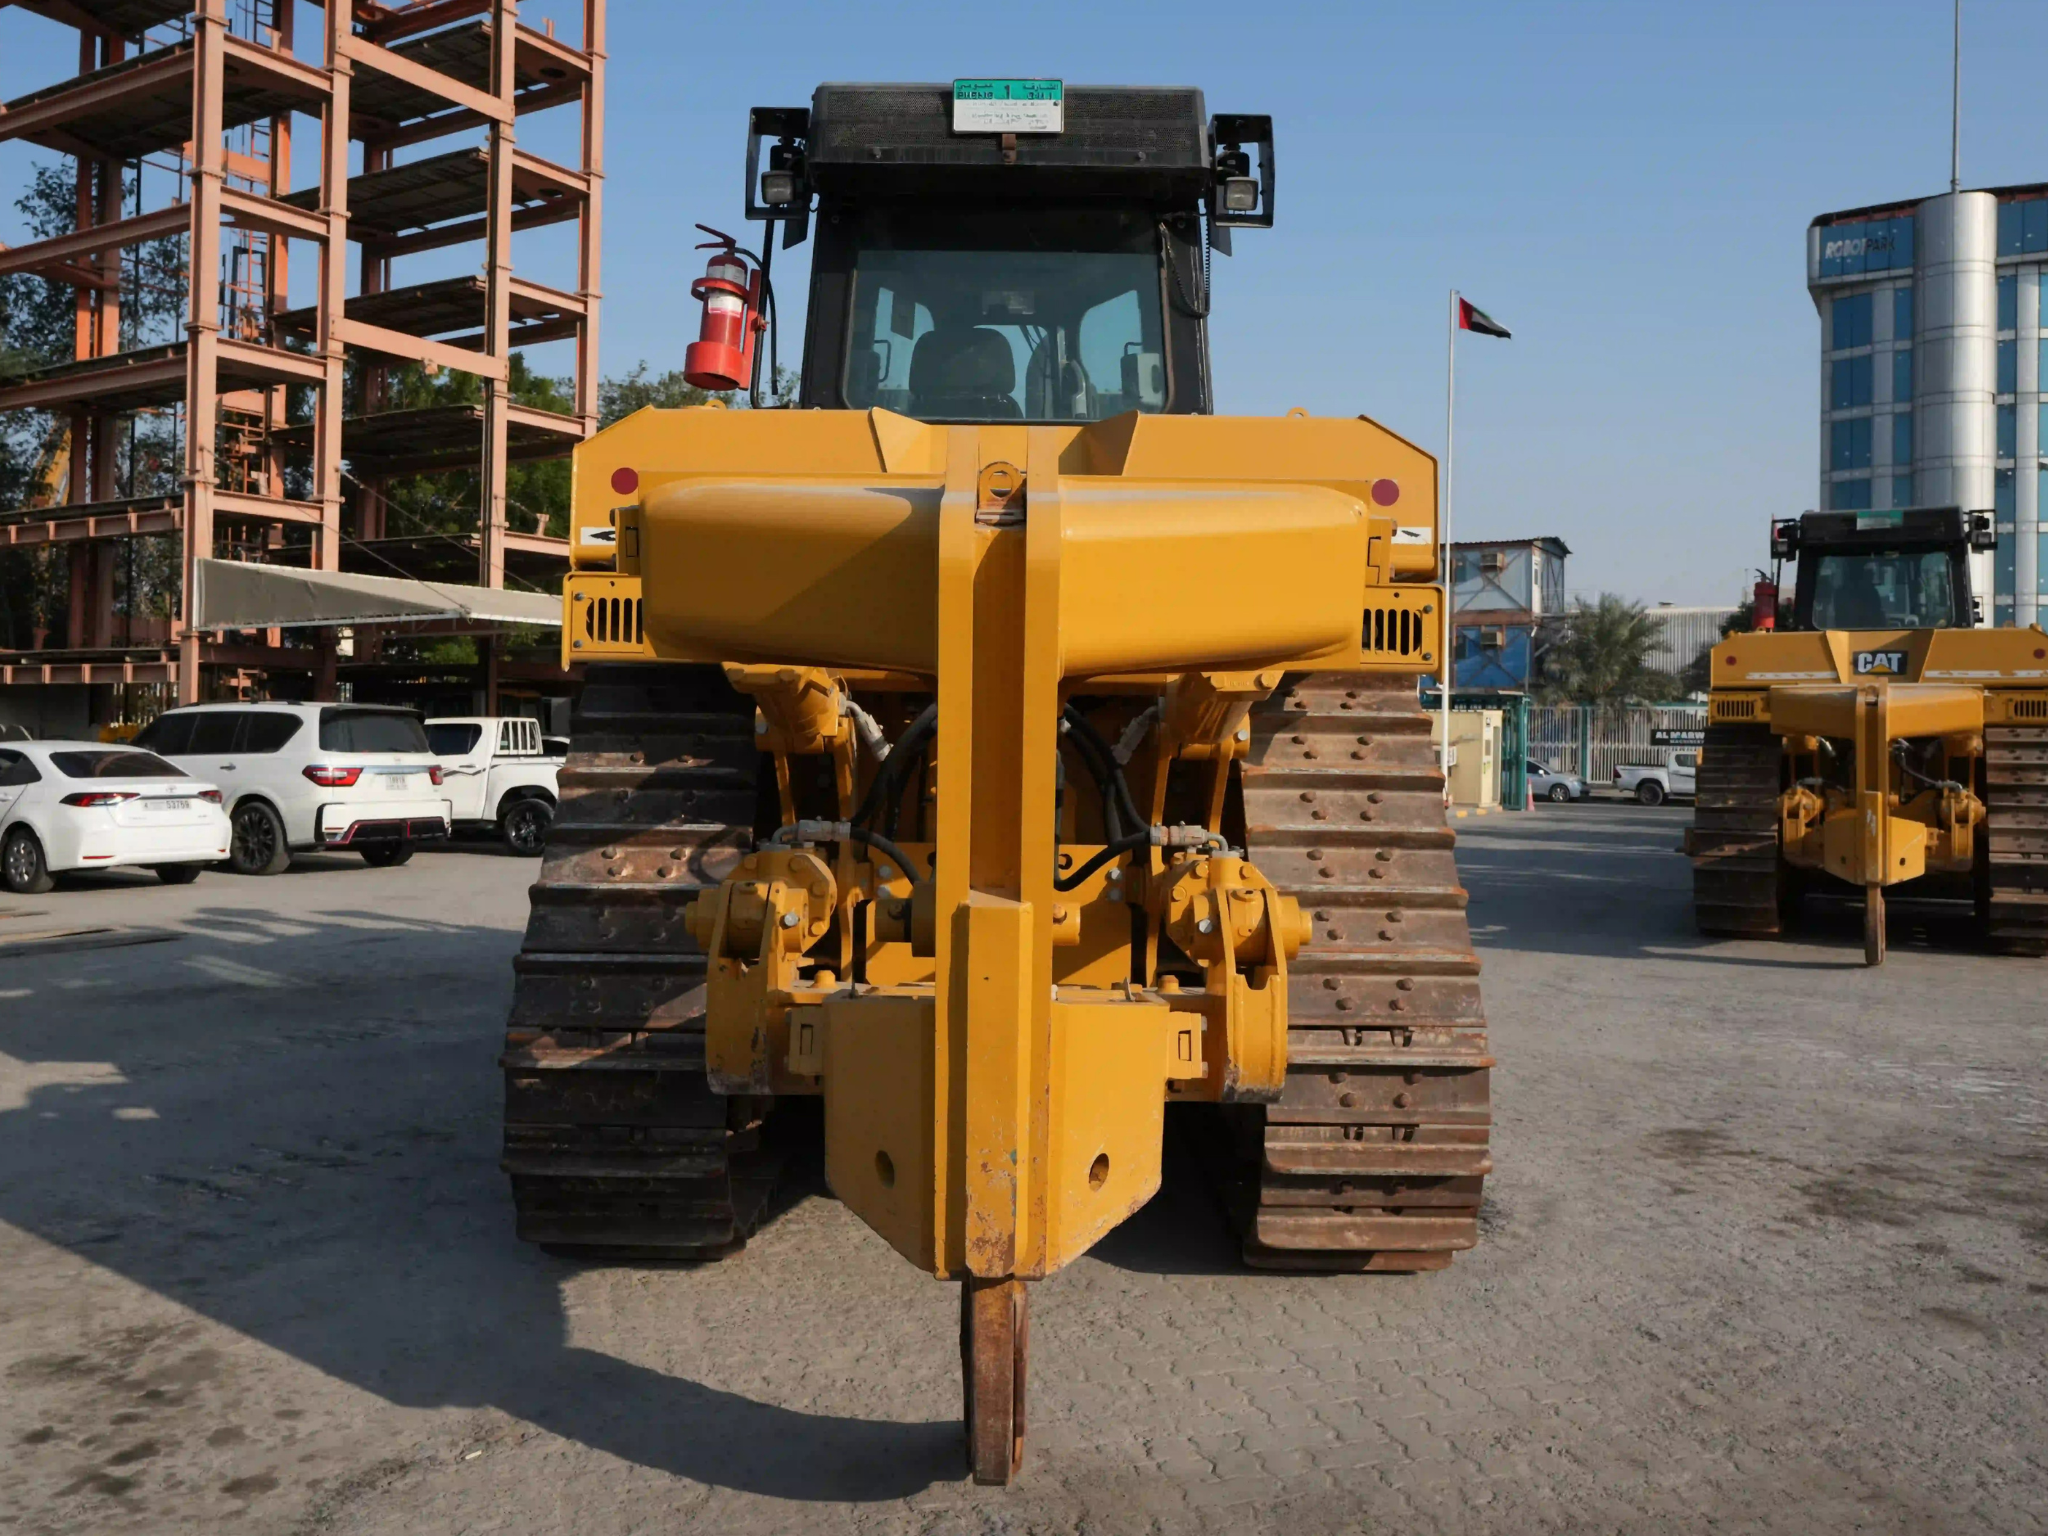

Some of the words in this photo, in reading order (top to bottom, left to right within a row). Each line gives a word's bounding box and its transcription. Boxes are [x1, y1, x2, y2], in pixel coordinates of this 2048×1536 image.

[1004, 84, 1011, 100] 1
[1022, 83, 1059, 92] الشارقة
[1857, 652, 1902, 673] CAT
[1655, 731, 1669, 739] AL
